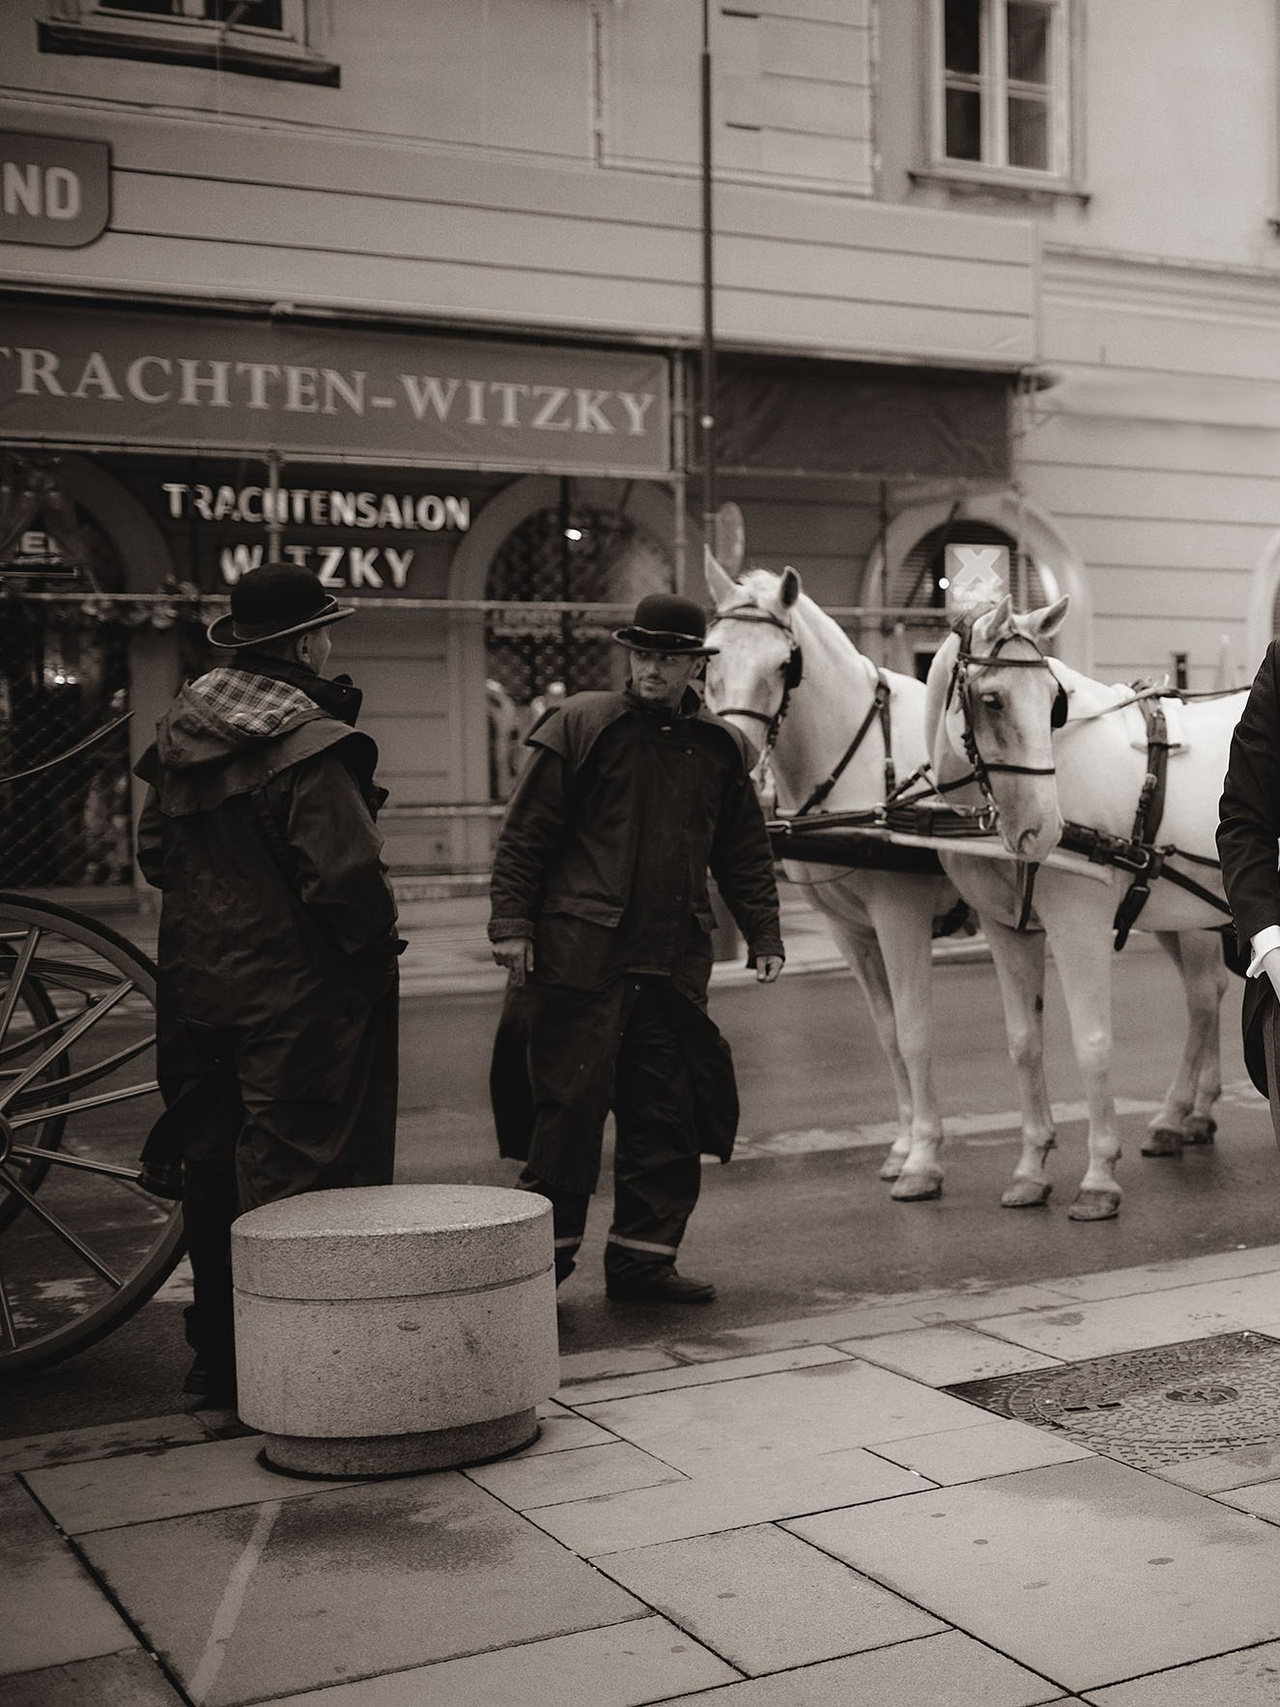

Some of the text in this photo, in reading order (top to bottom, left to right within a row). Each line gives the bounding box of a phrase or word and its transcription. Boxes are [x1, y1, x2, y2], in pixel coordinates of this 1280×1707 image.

[3, 161, 82, 220] ND
[0, 346, 654, 436] RACHTEN-WITZKY
[162, 483, 471, 532] TRACHTENSALON
[220, 543, 416, 589] WTZKY
